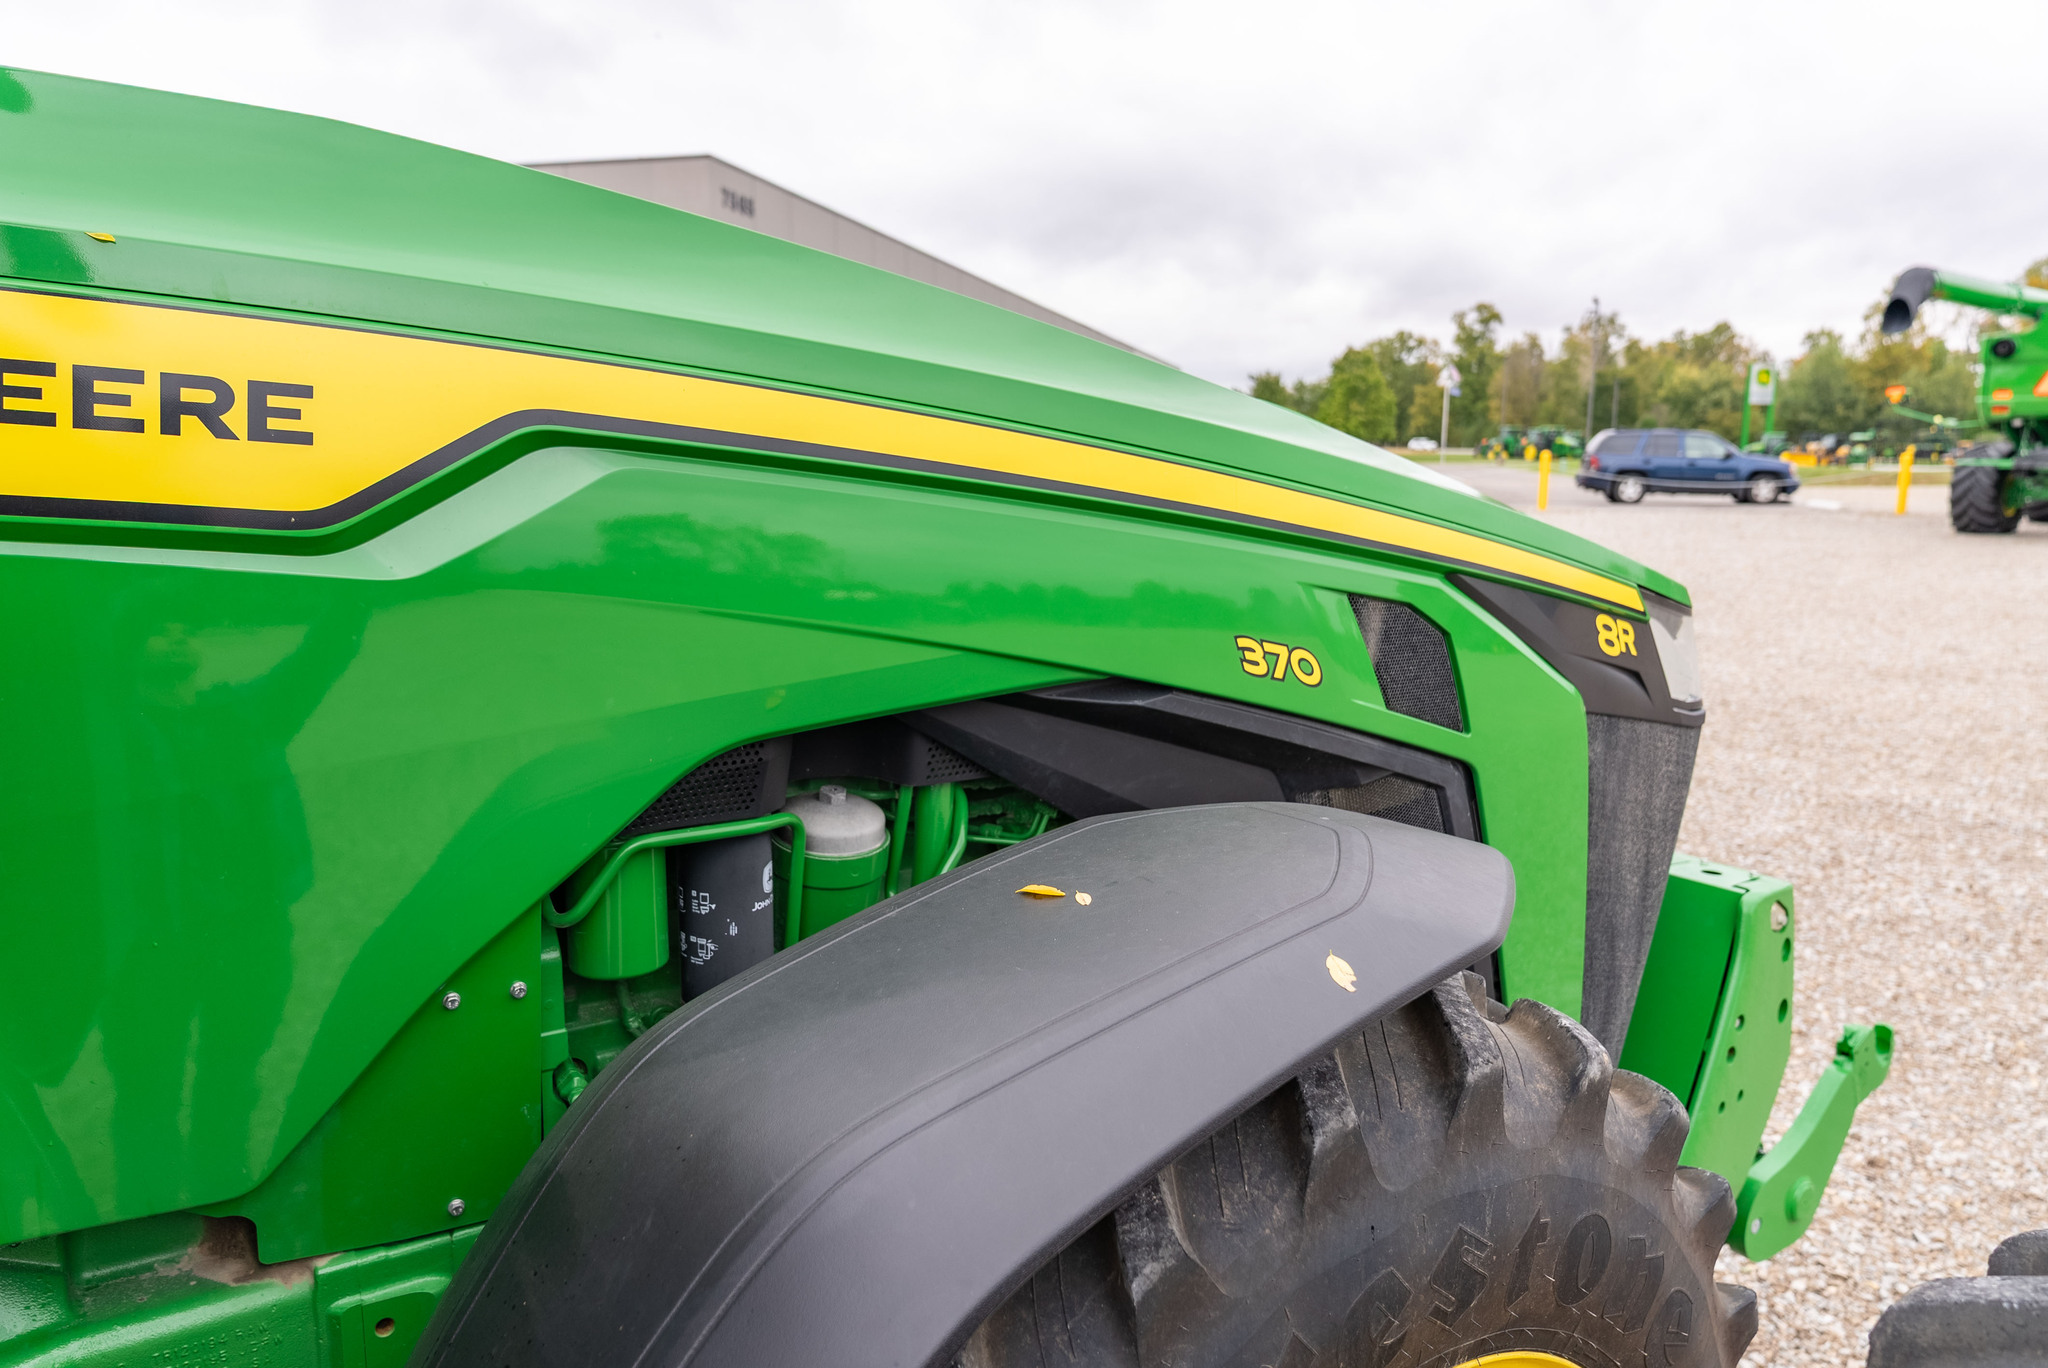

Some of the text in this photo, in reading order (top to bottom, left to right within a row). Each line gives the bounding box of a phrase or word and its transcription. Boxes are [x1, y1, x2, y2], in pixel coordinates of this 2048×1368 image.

[0, 358, 314, 446] EERE
[1234, 635, 1323, 688] 370
[1596, 613, 1638, 657] 8R
